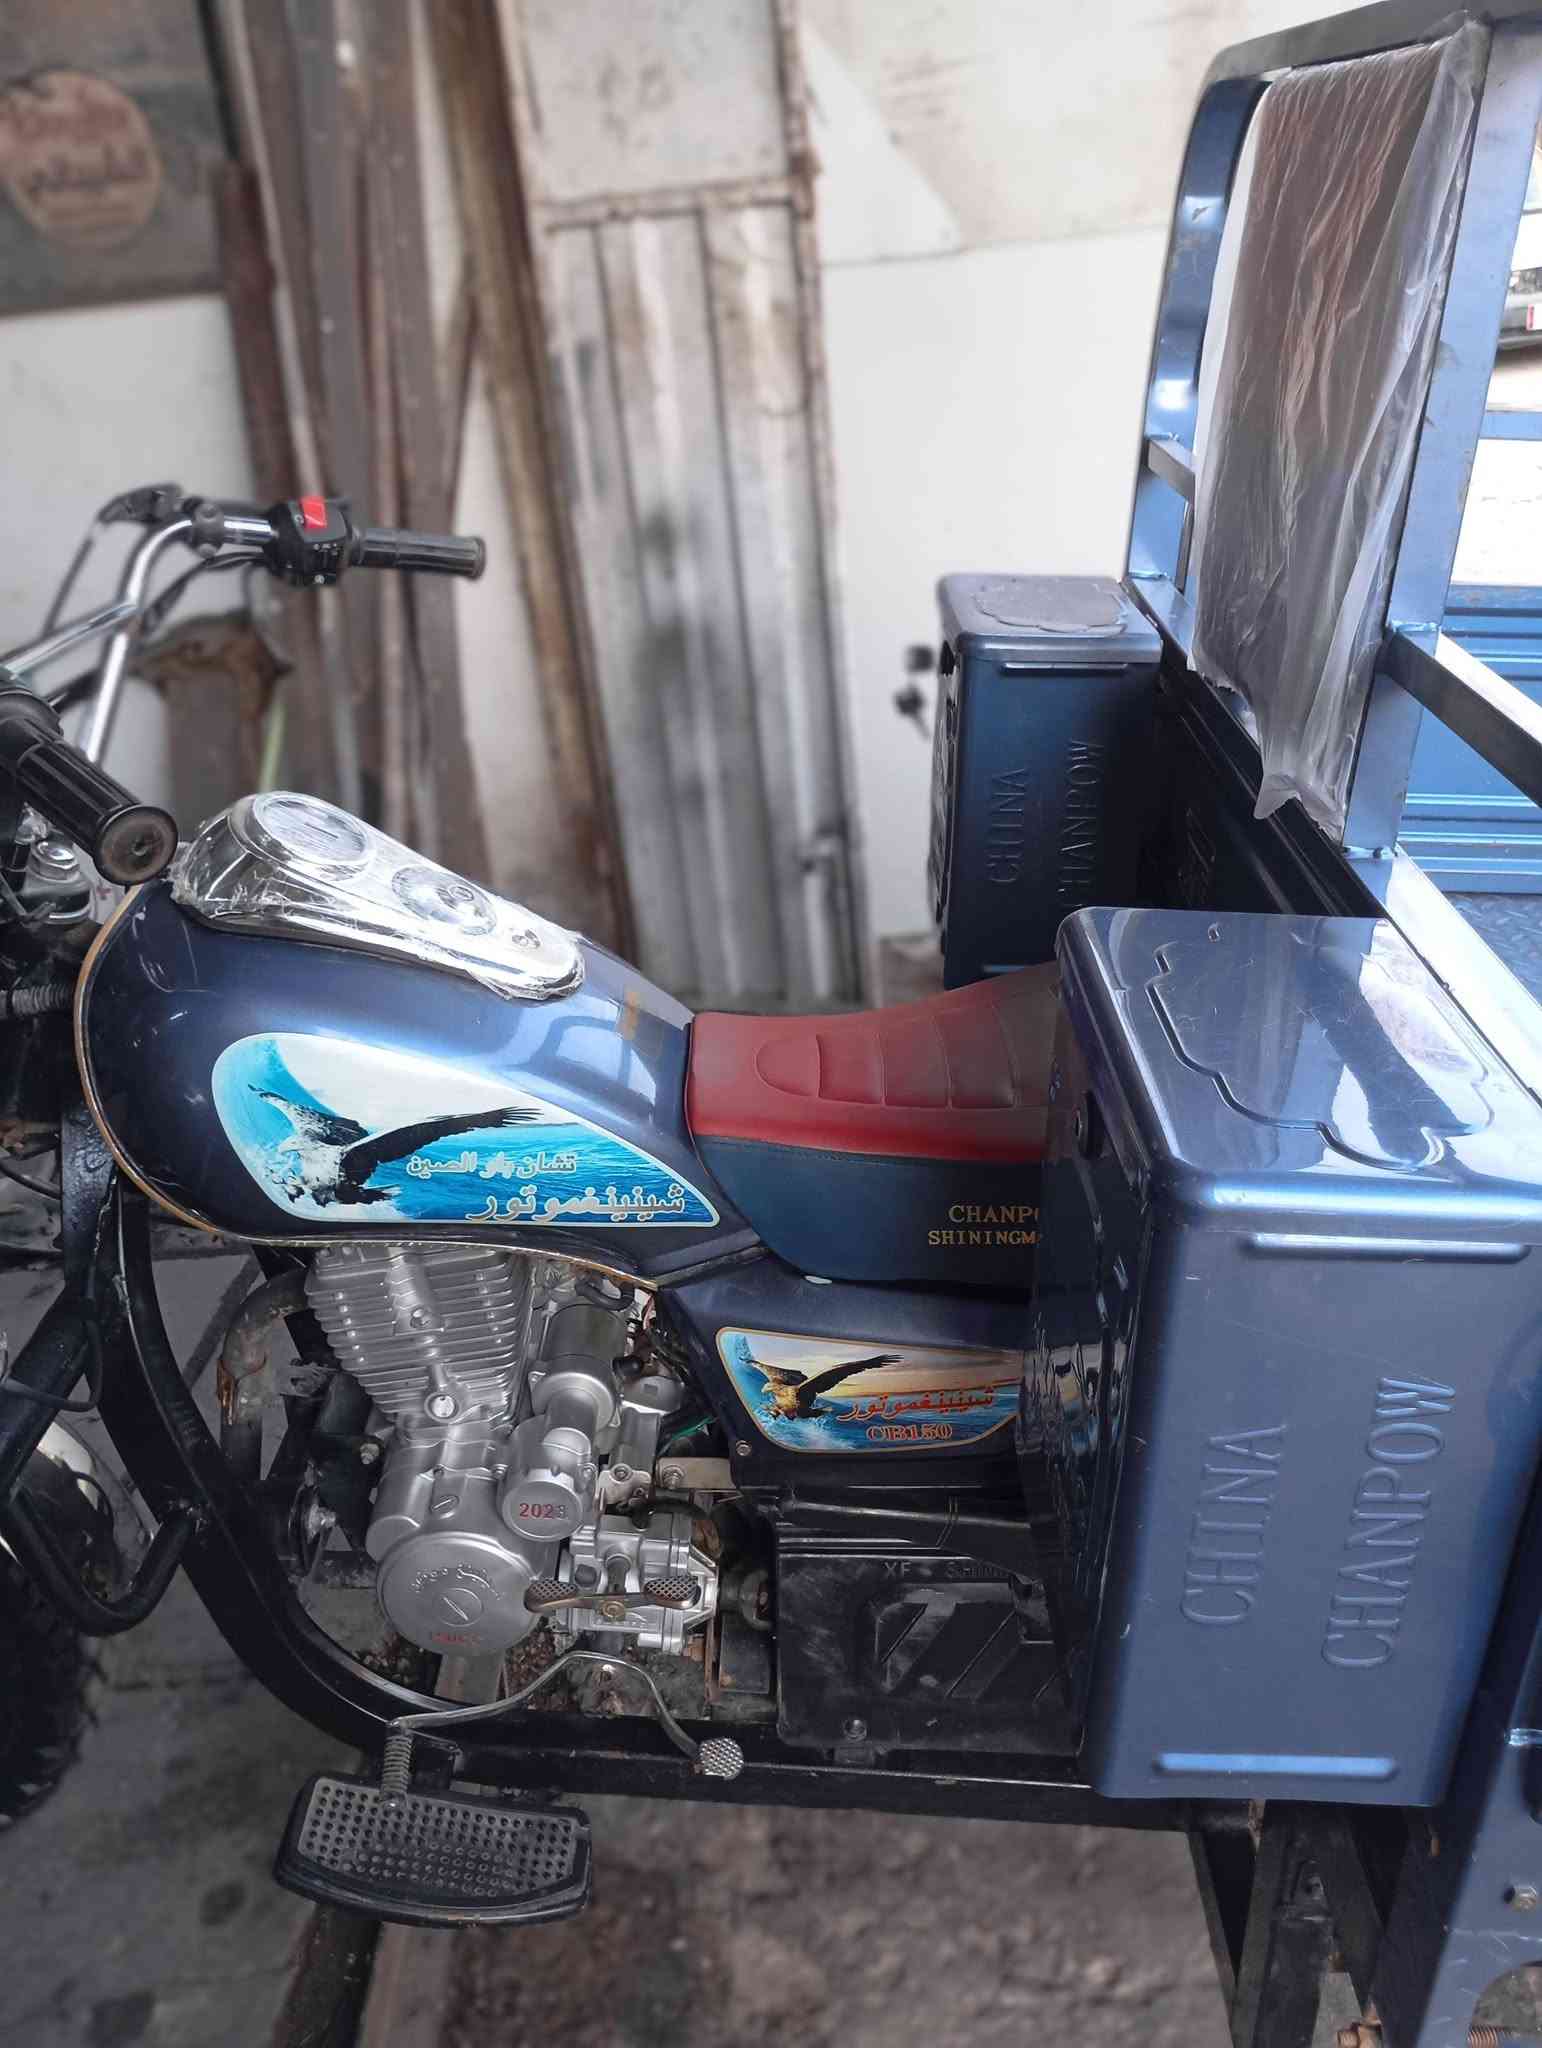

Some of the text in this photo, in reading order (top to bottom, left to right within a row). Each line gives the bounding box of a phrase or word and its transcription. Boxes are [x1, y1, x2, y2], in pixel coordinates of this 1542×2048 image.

[984, 768, 1029, 884] CHINA
[406, 1151, 478, 1178] الصين
[518, 1502, 568, 1520] 2023
[1179, 1422, 1288, 1626] CHINA
[1320, 1374, 1457, 1669] CHANPOW
